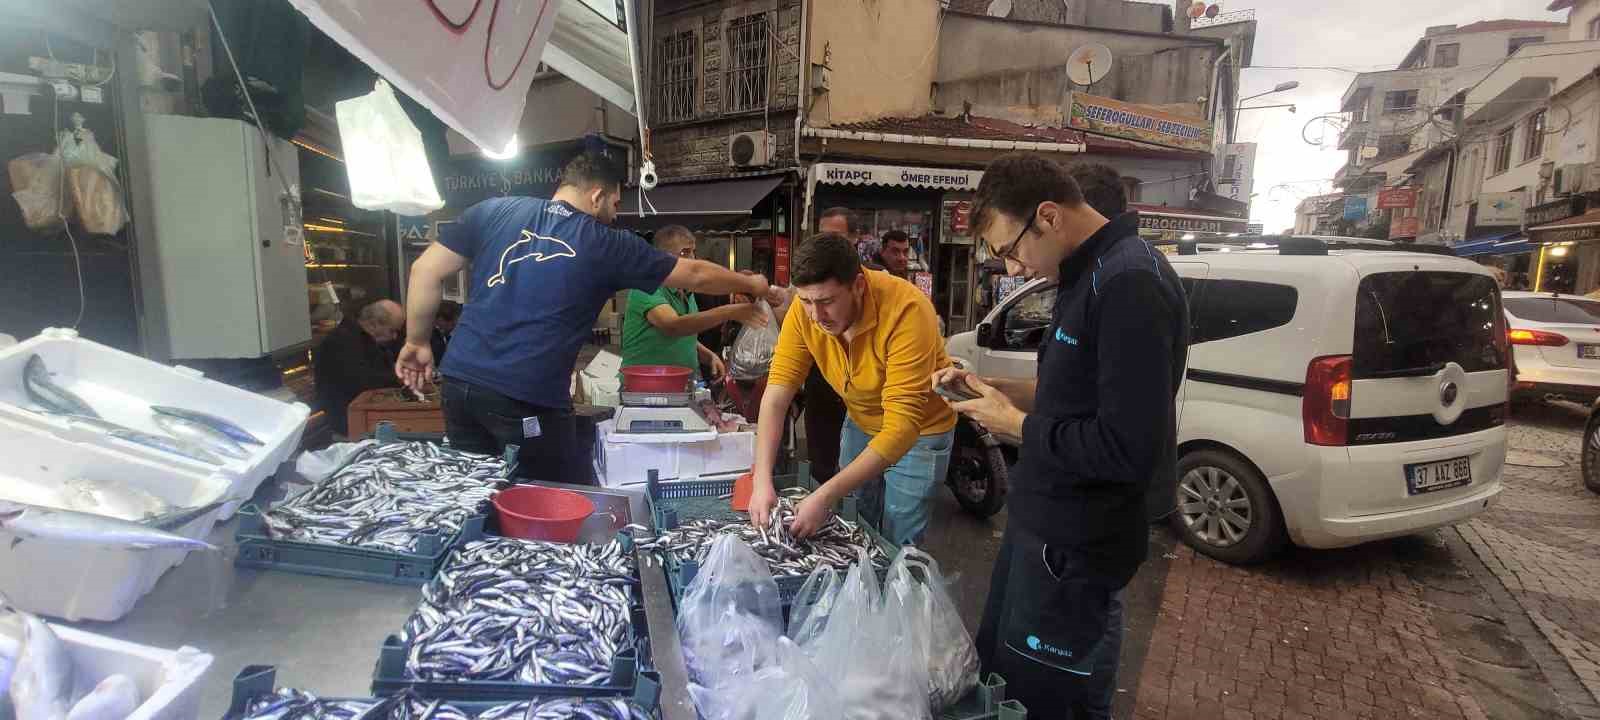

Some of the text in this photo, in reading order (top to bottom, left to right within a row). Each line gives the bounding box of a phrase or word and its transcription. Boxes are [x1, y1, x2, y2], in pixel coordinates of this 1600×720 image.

[826, 167, 969, 186] KİTAPÇI ÖMER EFENDİ
[1415, 467, 1428, 486] 37
[1435, 463, 1450, 482] AAZ
